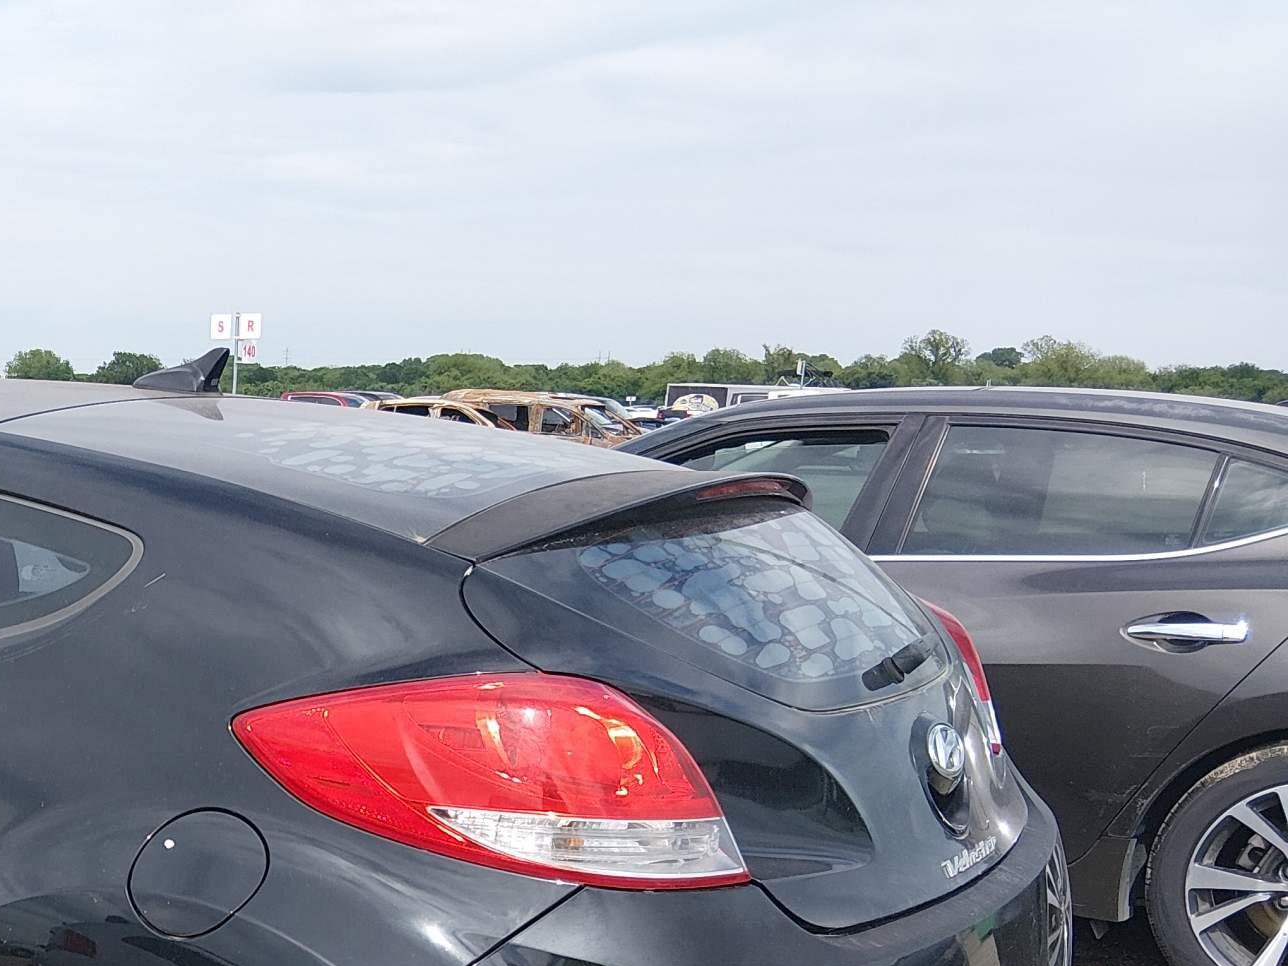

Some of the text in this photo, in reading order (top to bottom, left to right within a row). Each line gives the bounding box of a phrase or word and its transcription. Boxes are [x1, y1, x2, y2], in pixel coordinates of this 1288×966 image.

[217, 320, 225, 333] S
[247, 320, 255, 332] R
[242, 344, 256, 358] 140
